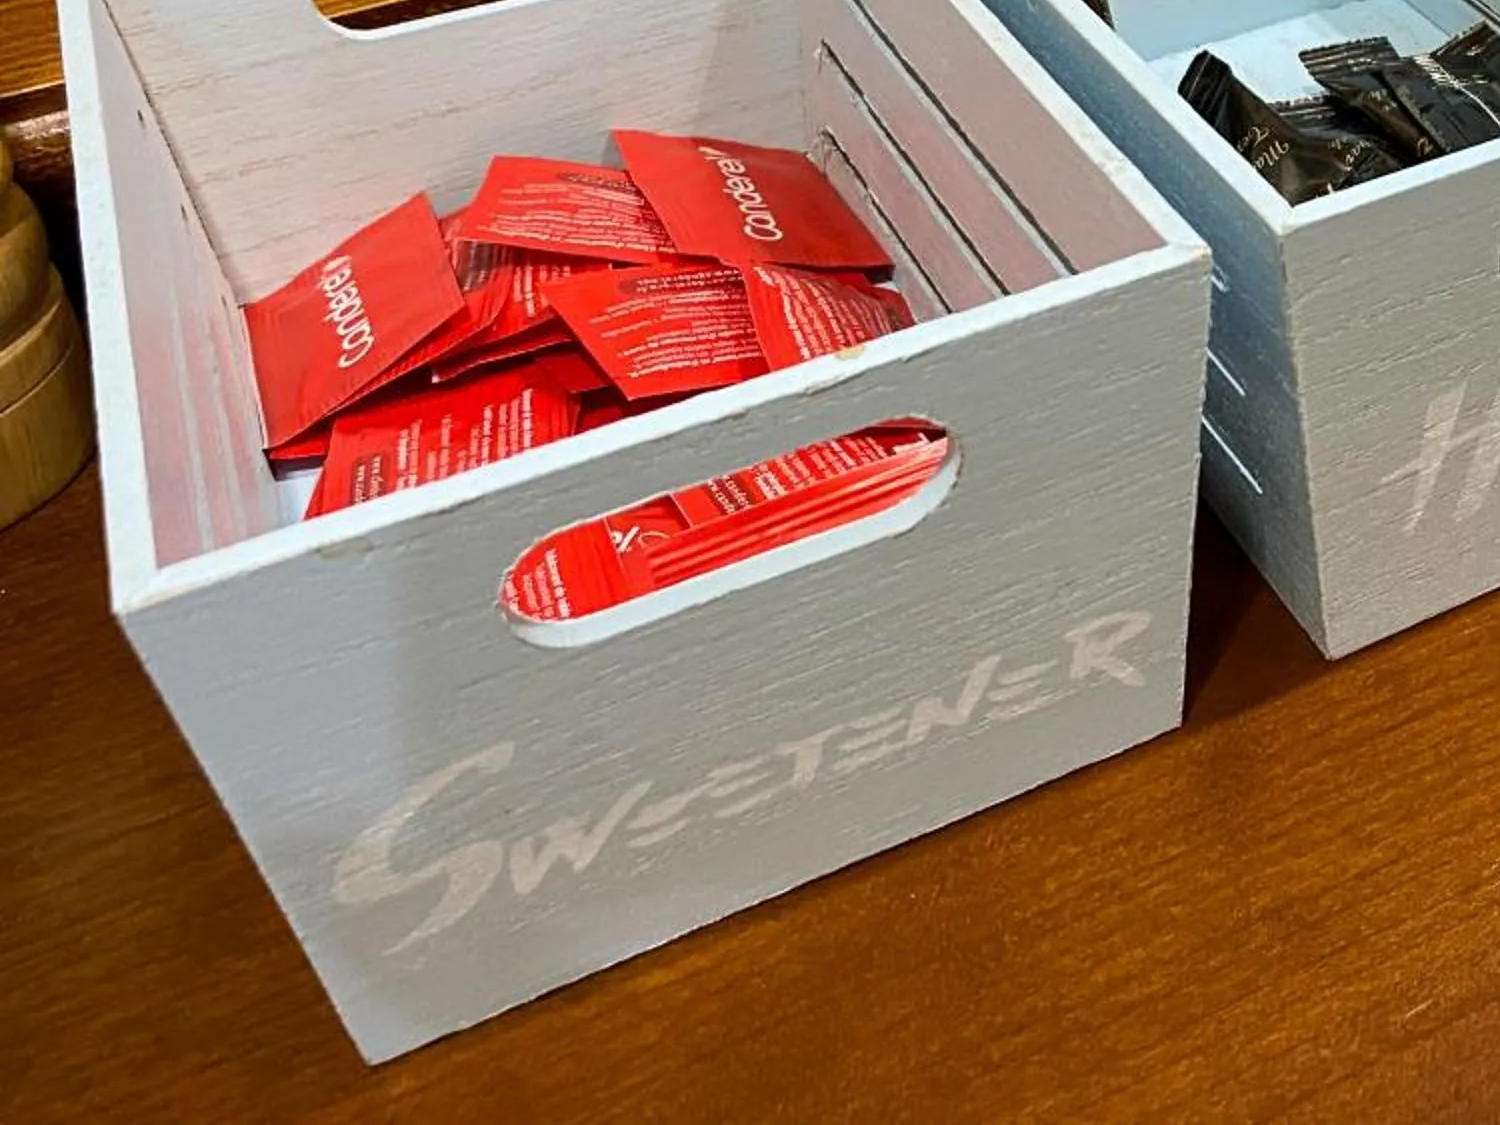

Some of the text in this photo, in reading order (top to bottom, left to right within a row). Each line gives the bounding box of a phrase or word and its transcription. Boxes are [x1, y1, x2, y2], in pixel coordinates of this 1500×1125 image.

[697, 145, 784, 242] Canderel
[320, 254, 376, 369] Canderel
[331, 611, 1154, 956] SWEETENER
